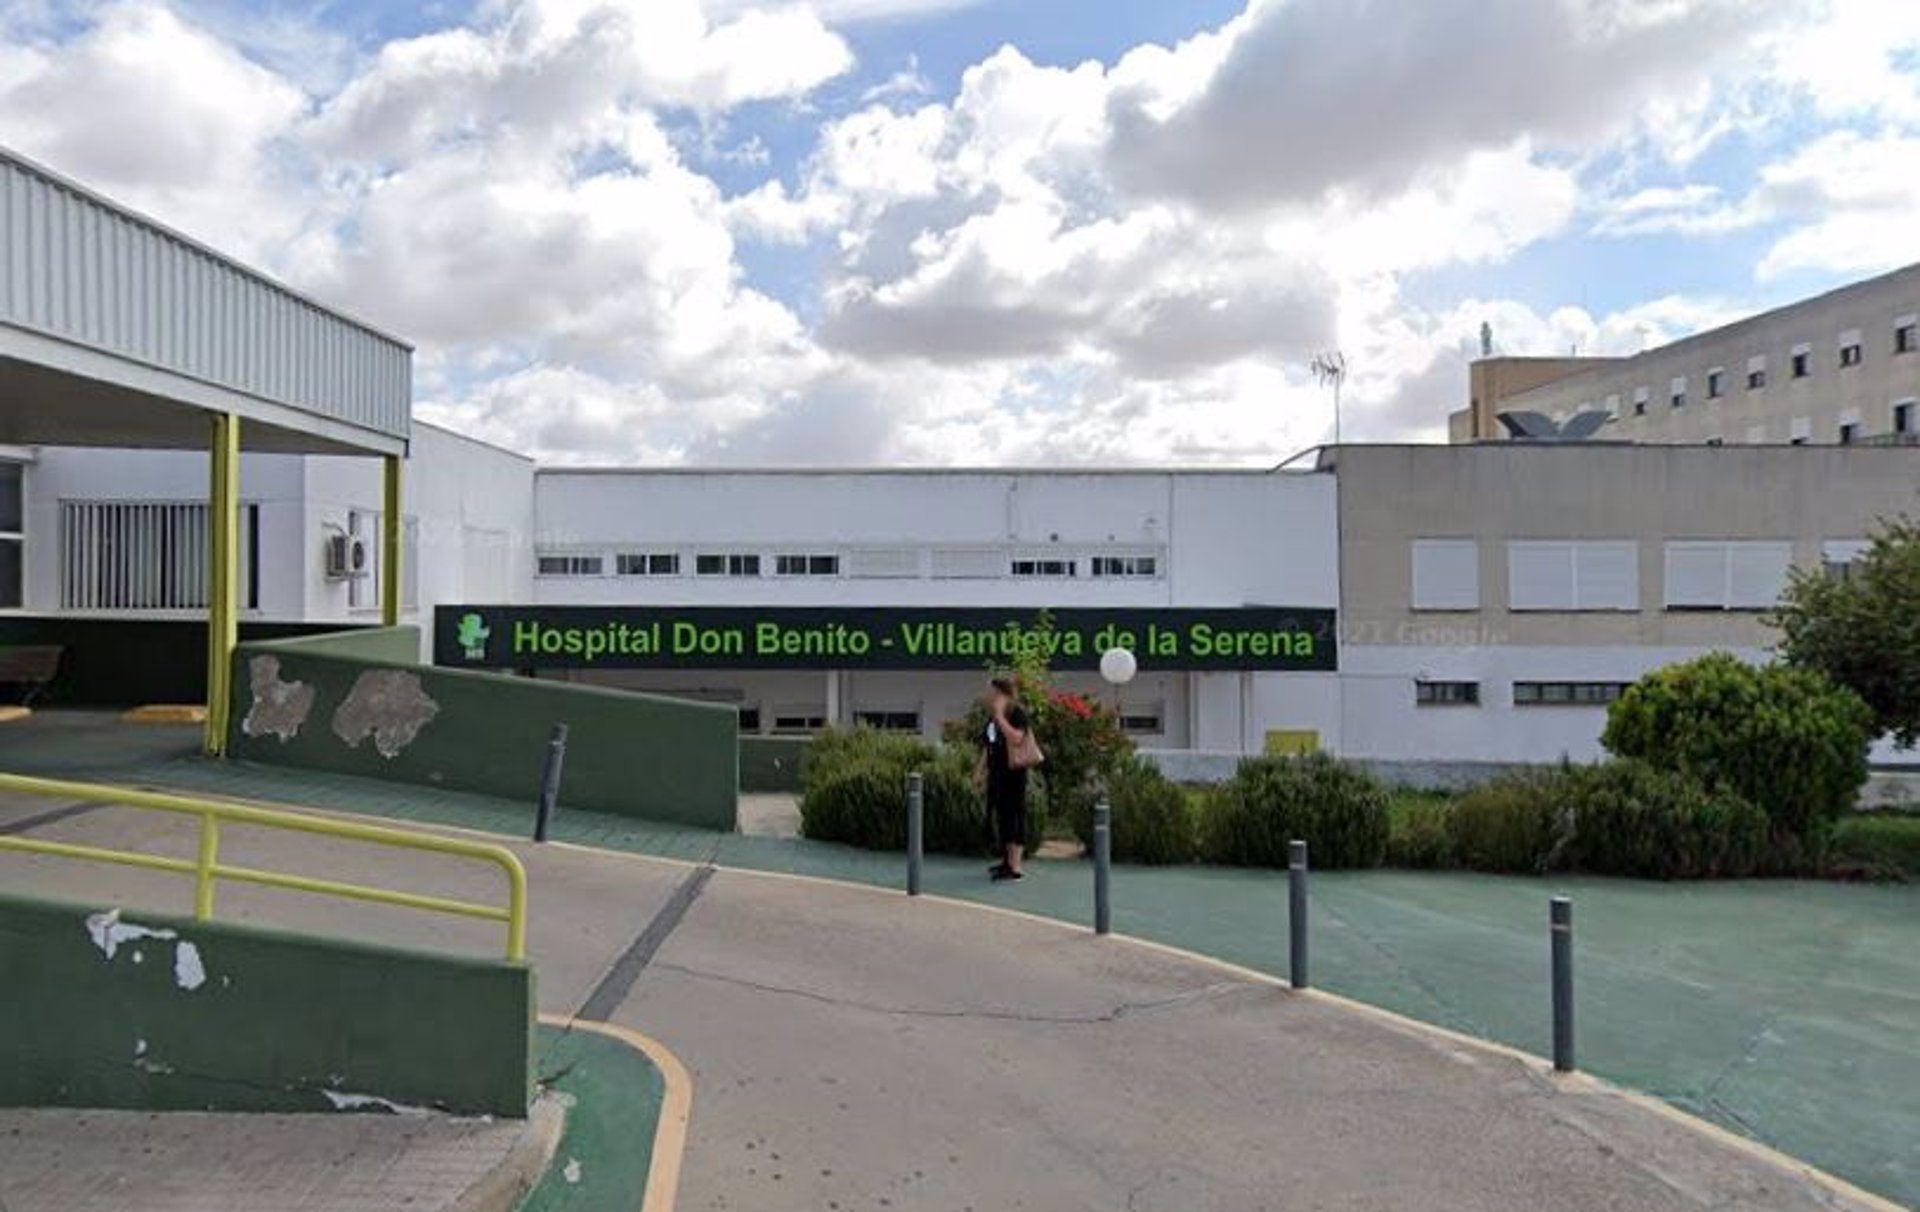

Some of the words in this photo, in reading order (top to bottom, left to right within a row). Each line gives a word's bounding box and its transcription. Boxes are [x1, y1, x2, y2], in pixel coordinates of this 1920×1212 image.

[514, 622, 660, 661] Hospital
[674, 623, 743, 654] Don
[757, 622, 870, 655] Benito
[901, 623, 1082, 656] Villanueva
[1094, 623, 1137, 655] de
[1149, 623, 1178, 656] la
[1190, 623, 1314, 657] Serena
